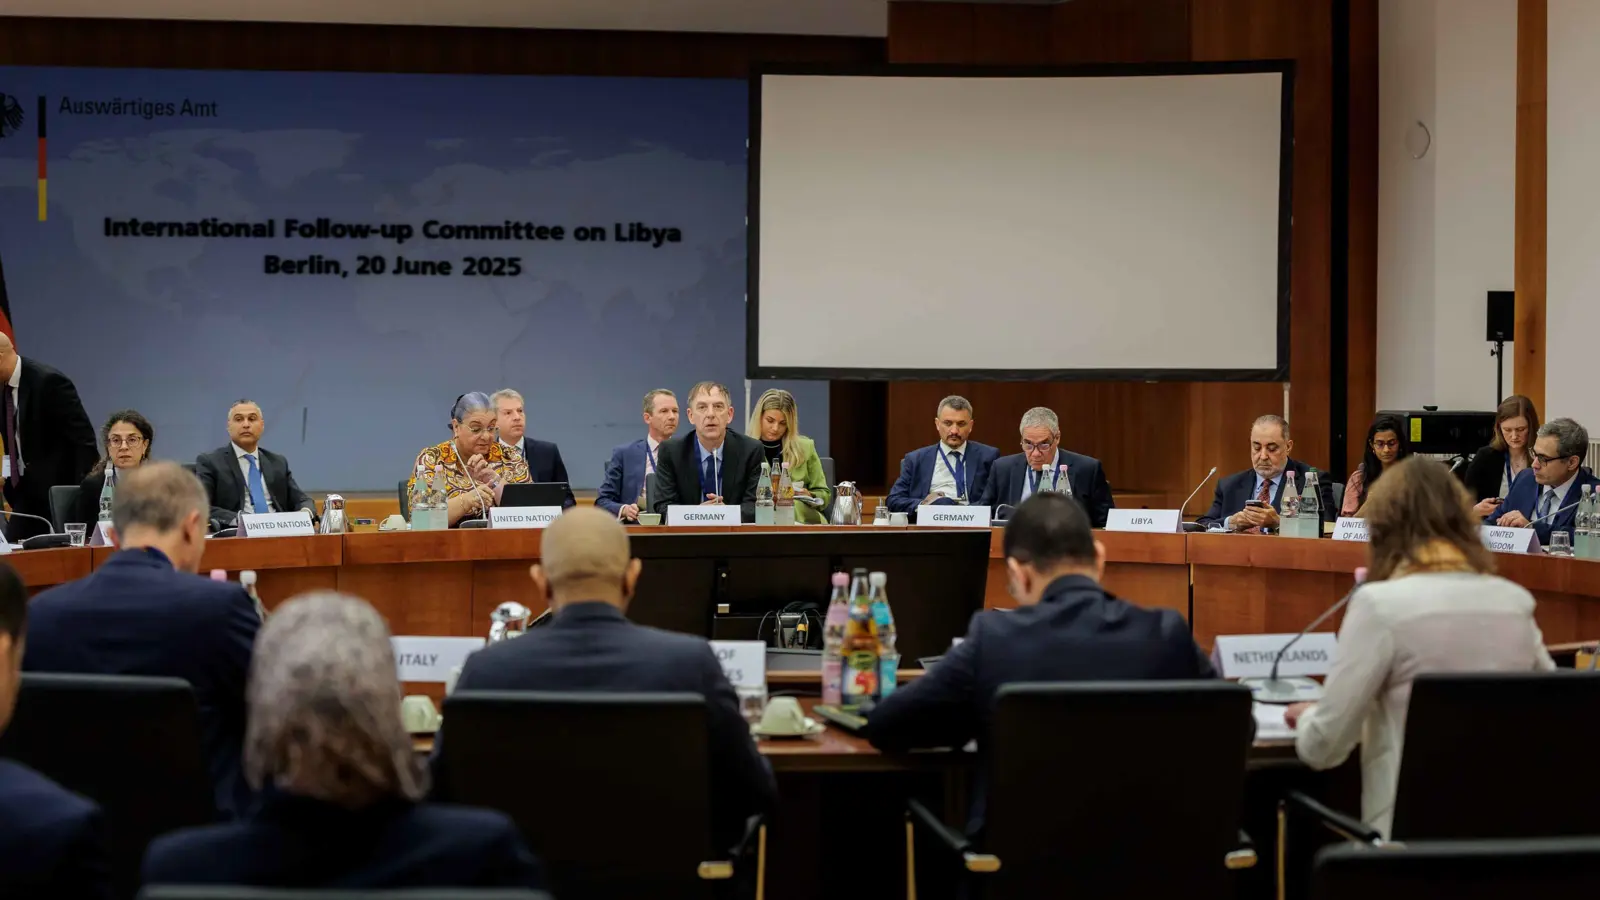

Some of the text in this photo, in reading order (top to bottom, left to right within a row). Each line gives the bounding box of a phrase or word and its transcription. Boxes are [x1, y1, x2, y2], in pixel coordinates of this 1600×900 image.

[59, 96, 219, 120] Auswärtiges Amt
[104, 217, 682, 248] International Follow-up Committee on Libya
[263, 254, 522, 278] Berlin, 20 June 2025
[493, 515, 524, 523] UNITED
[683, 513, 726, 521] GERMANY
[933, 513, 975, 522] GERMANY
[1131, 517, 1153, 525] LIBYA
[246, 520, 311, 531] UNITED NATIONS
[1490, 530, 1515, 539] UNITED
[1487, 541, 1515, 550] NGDOM
[399, 653, 438, 667] ITALY
